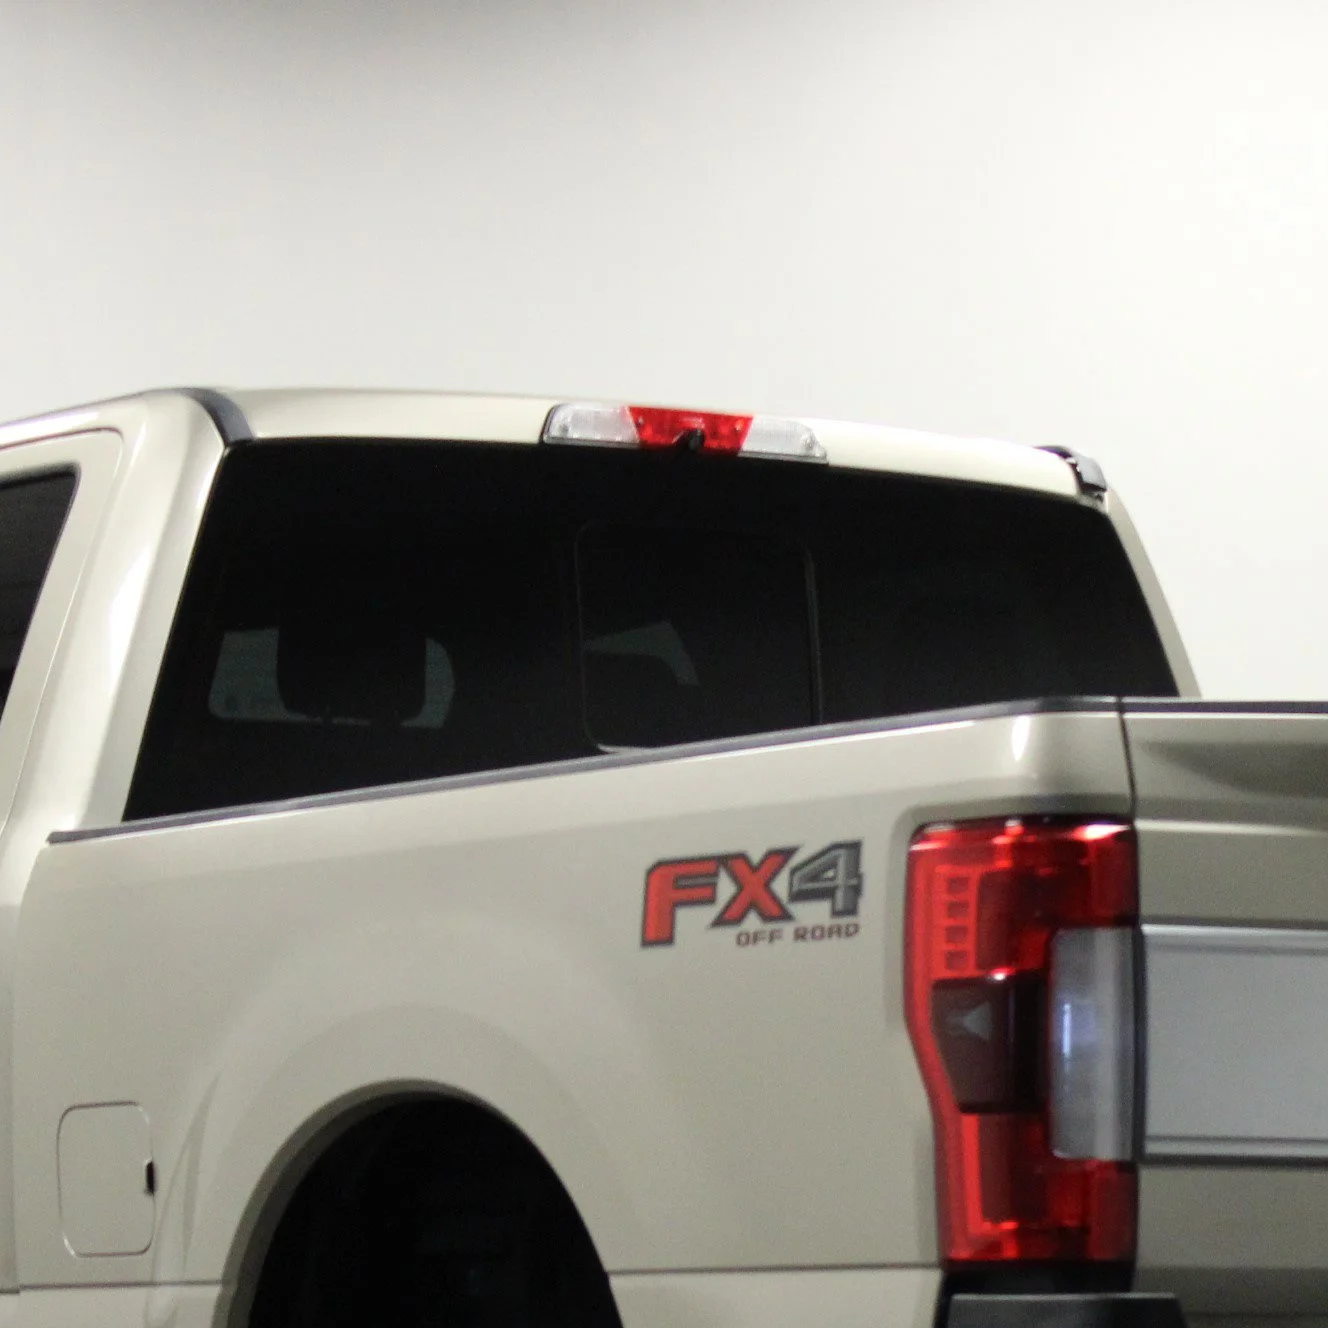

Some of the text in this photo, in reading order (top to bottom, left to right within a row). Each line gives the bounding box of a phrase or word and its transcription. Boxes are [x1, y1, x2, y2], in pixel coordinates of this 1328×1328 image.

[640, 839, 864, 949] FX4
[735, 922, 860, 947] OFF ROAD
